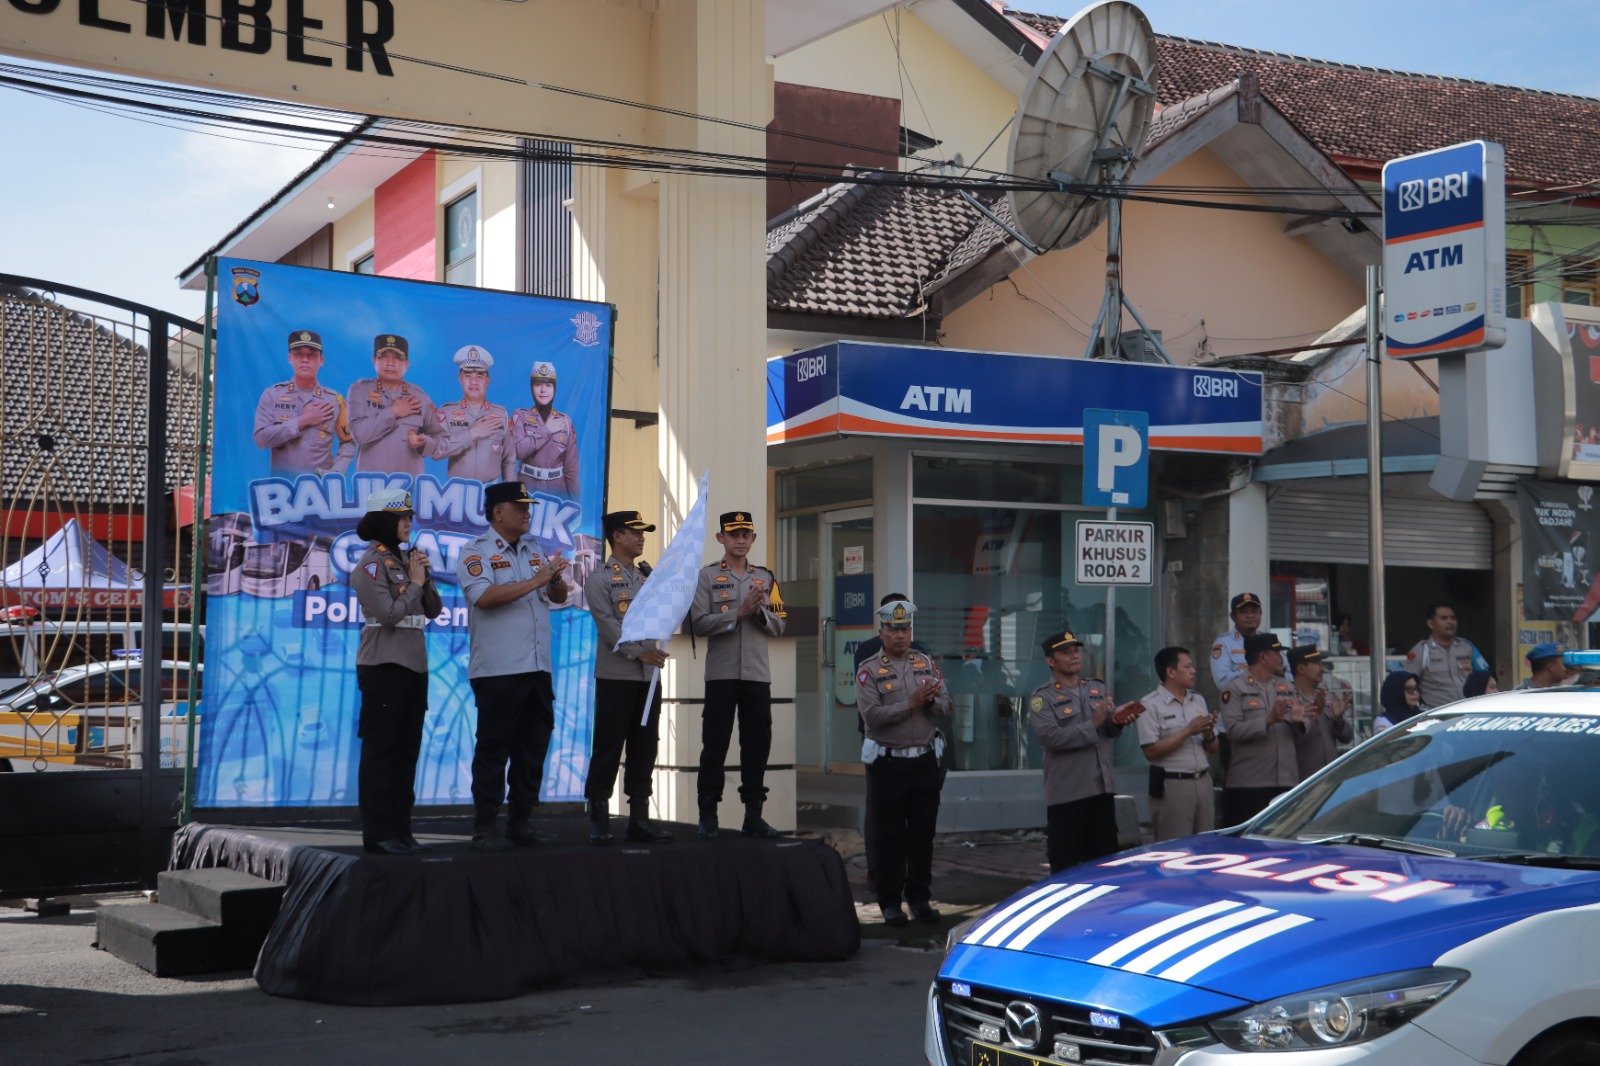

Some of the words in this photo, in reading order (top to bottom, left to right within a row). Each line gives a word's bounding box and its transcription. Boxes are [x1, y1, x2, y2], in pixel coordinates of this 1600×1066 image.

[1428, 172, 1468, 204] BRI
[1404, 244, 1463, 274] ATM
[808, 355, 827, 378] BRI
[1211, 378, 1238, 398] BRI
[900, 385, 972, 413] ATM
[1098, 424, 1142, 492] P
[1085, 527, 1144, 543] PARKIR
[1082, 547, 1147, 561] KHUSUS
[1084, 564, 1127, 578] RODA
[1131, 564, 1140, 578] 2
[852, 593, 866, 607] BRI
[1525, 717, 1590, 733] POLRES
[1097, 850, 1456, 903] POLISI
